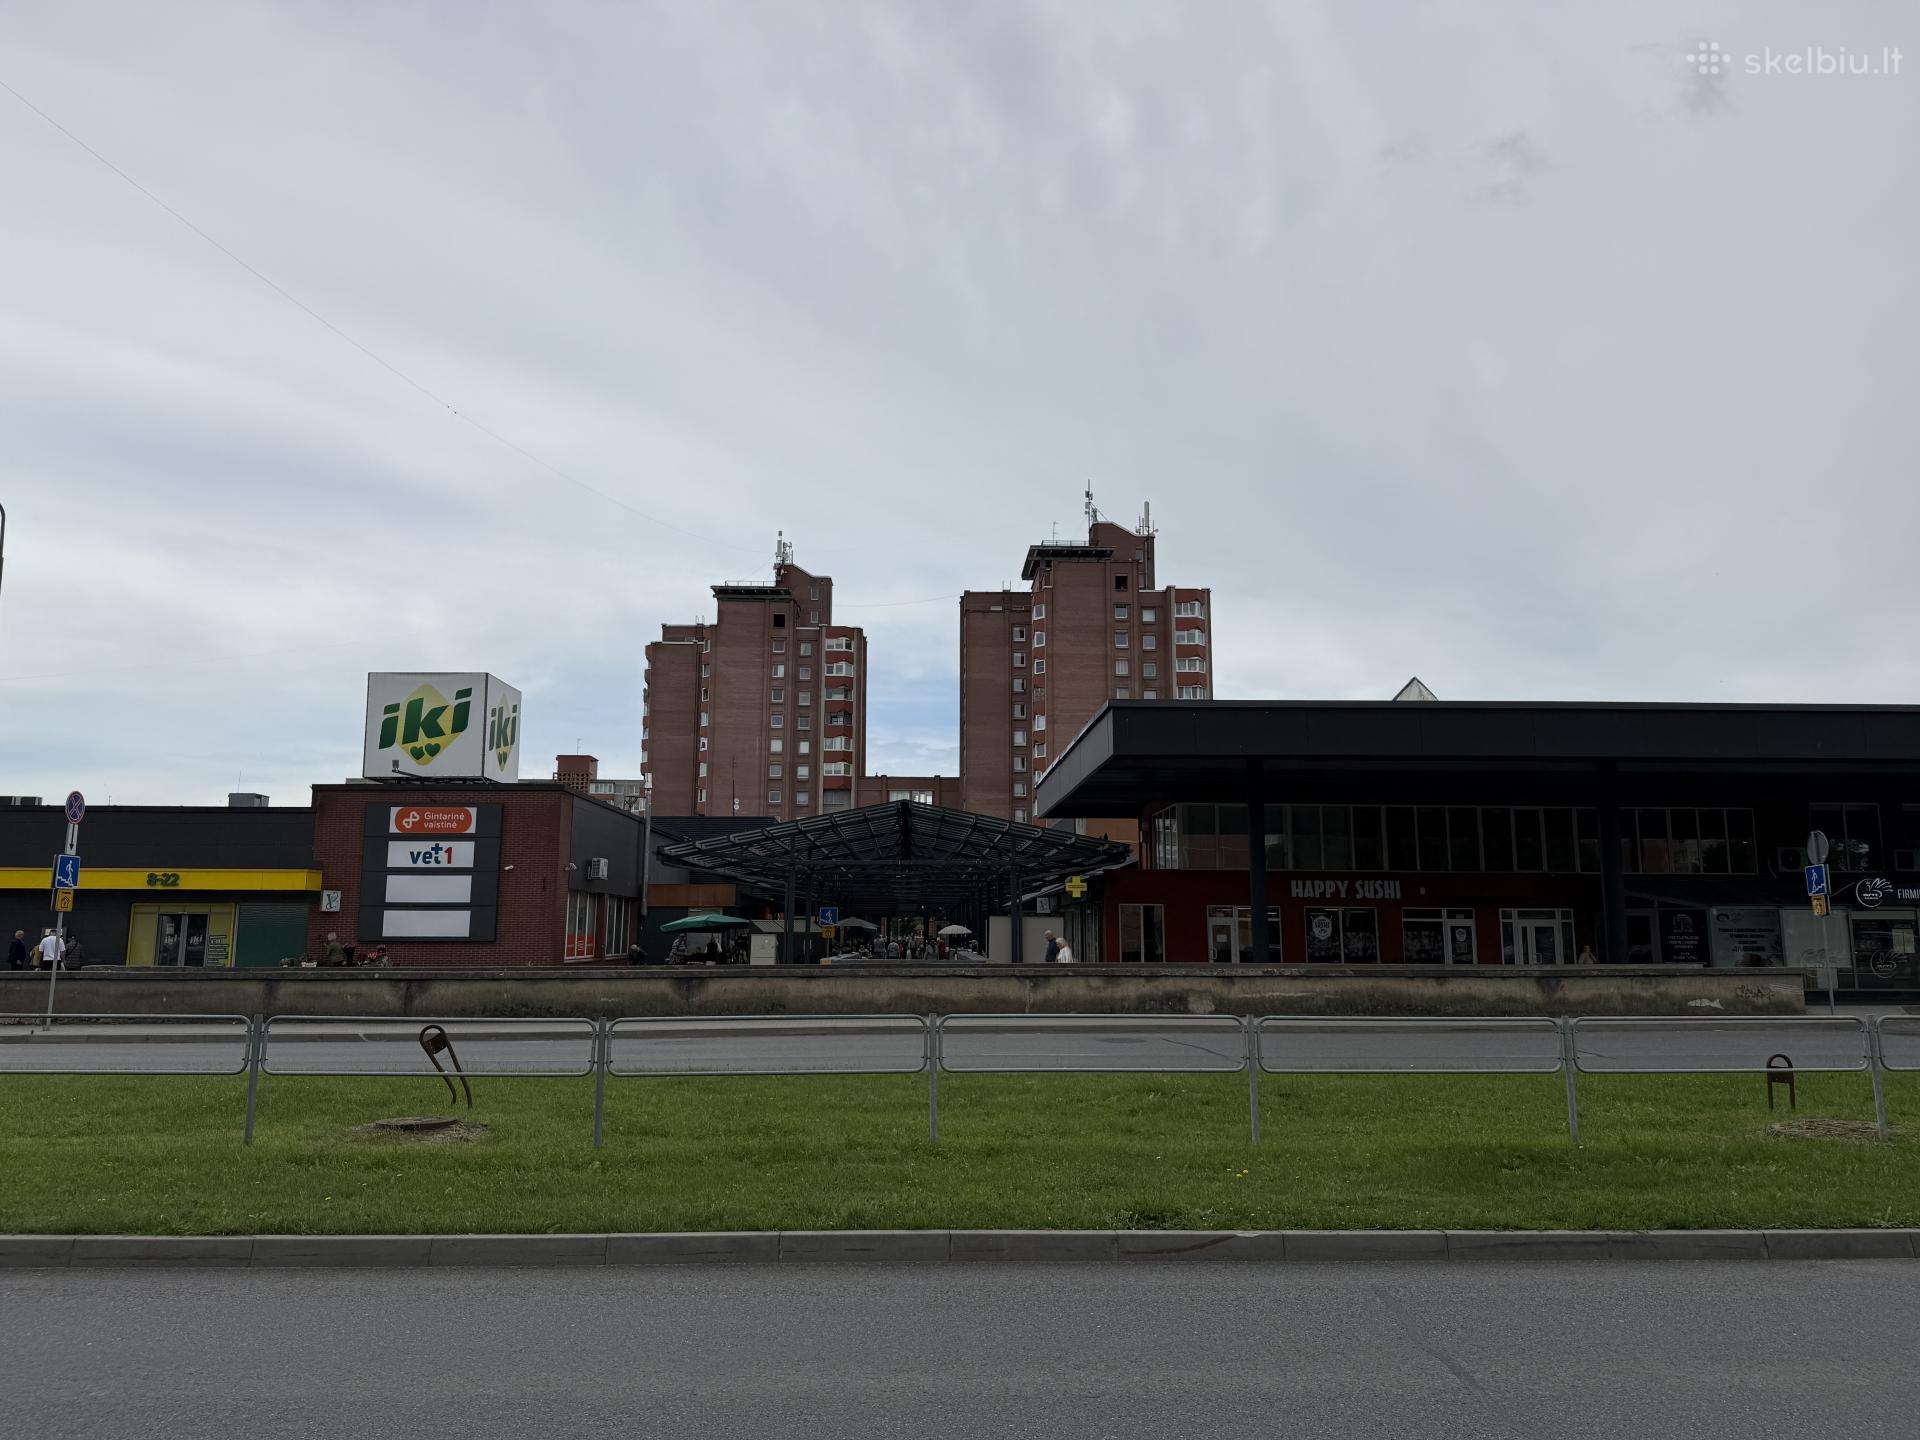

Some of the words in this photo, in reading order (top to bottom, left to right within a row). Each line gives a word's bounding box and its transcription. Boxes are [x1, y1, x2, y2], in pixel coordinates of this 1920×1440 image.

[424, 811, 465, 821] Gintarinė
[423, 820, 458, 829] vaistinė
[1290, 879, 1349, 898] HAPPY
[1355, 879, 1402, 900] SUSHI
